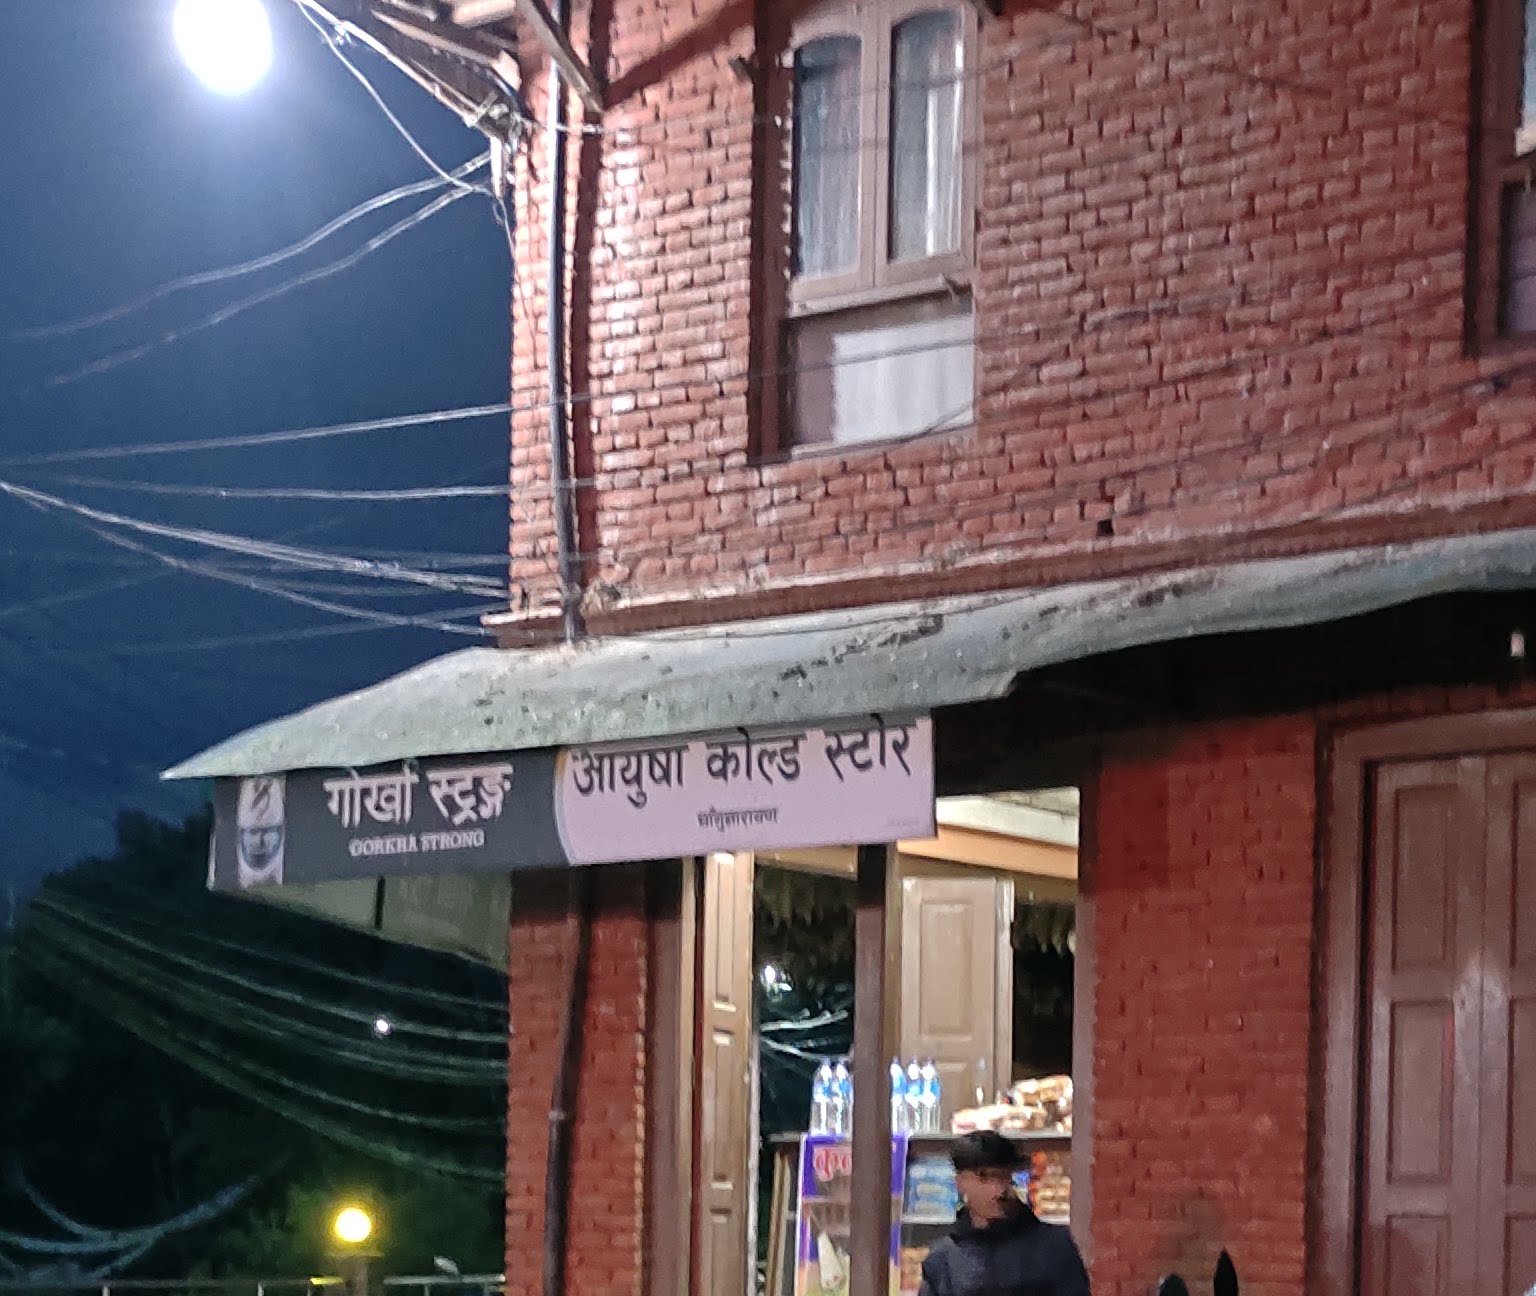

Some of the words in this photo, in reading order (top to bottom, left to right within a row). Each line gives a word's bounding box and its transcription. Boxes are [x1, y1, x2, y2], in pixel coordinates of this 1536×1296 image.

[571, 745, 688, 809] आयुषा
[706, 726, 807, 786] कोल्ड
[823, 712, 916, 783] स्टोर
[349, 834, 418, 857] GORKHA
[420, 828, 485, 852] STRONG
